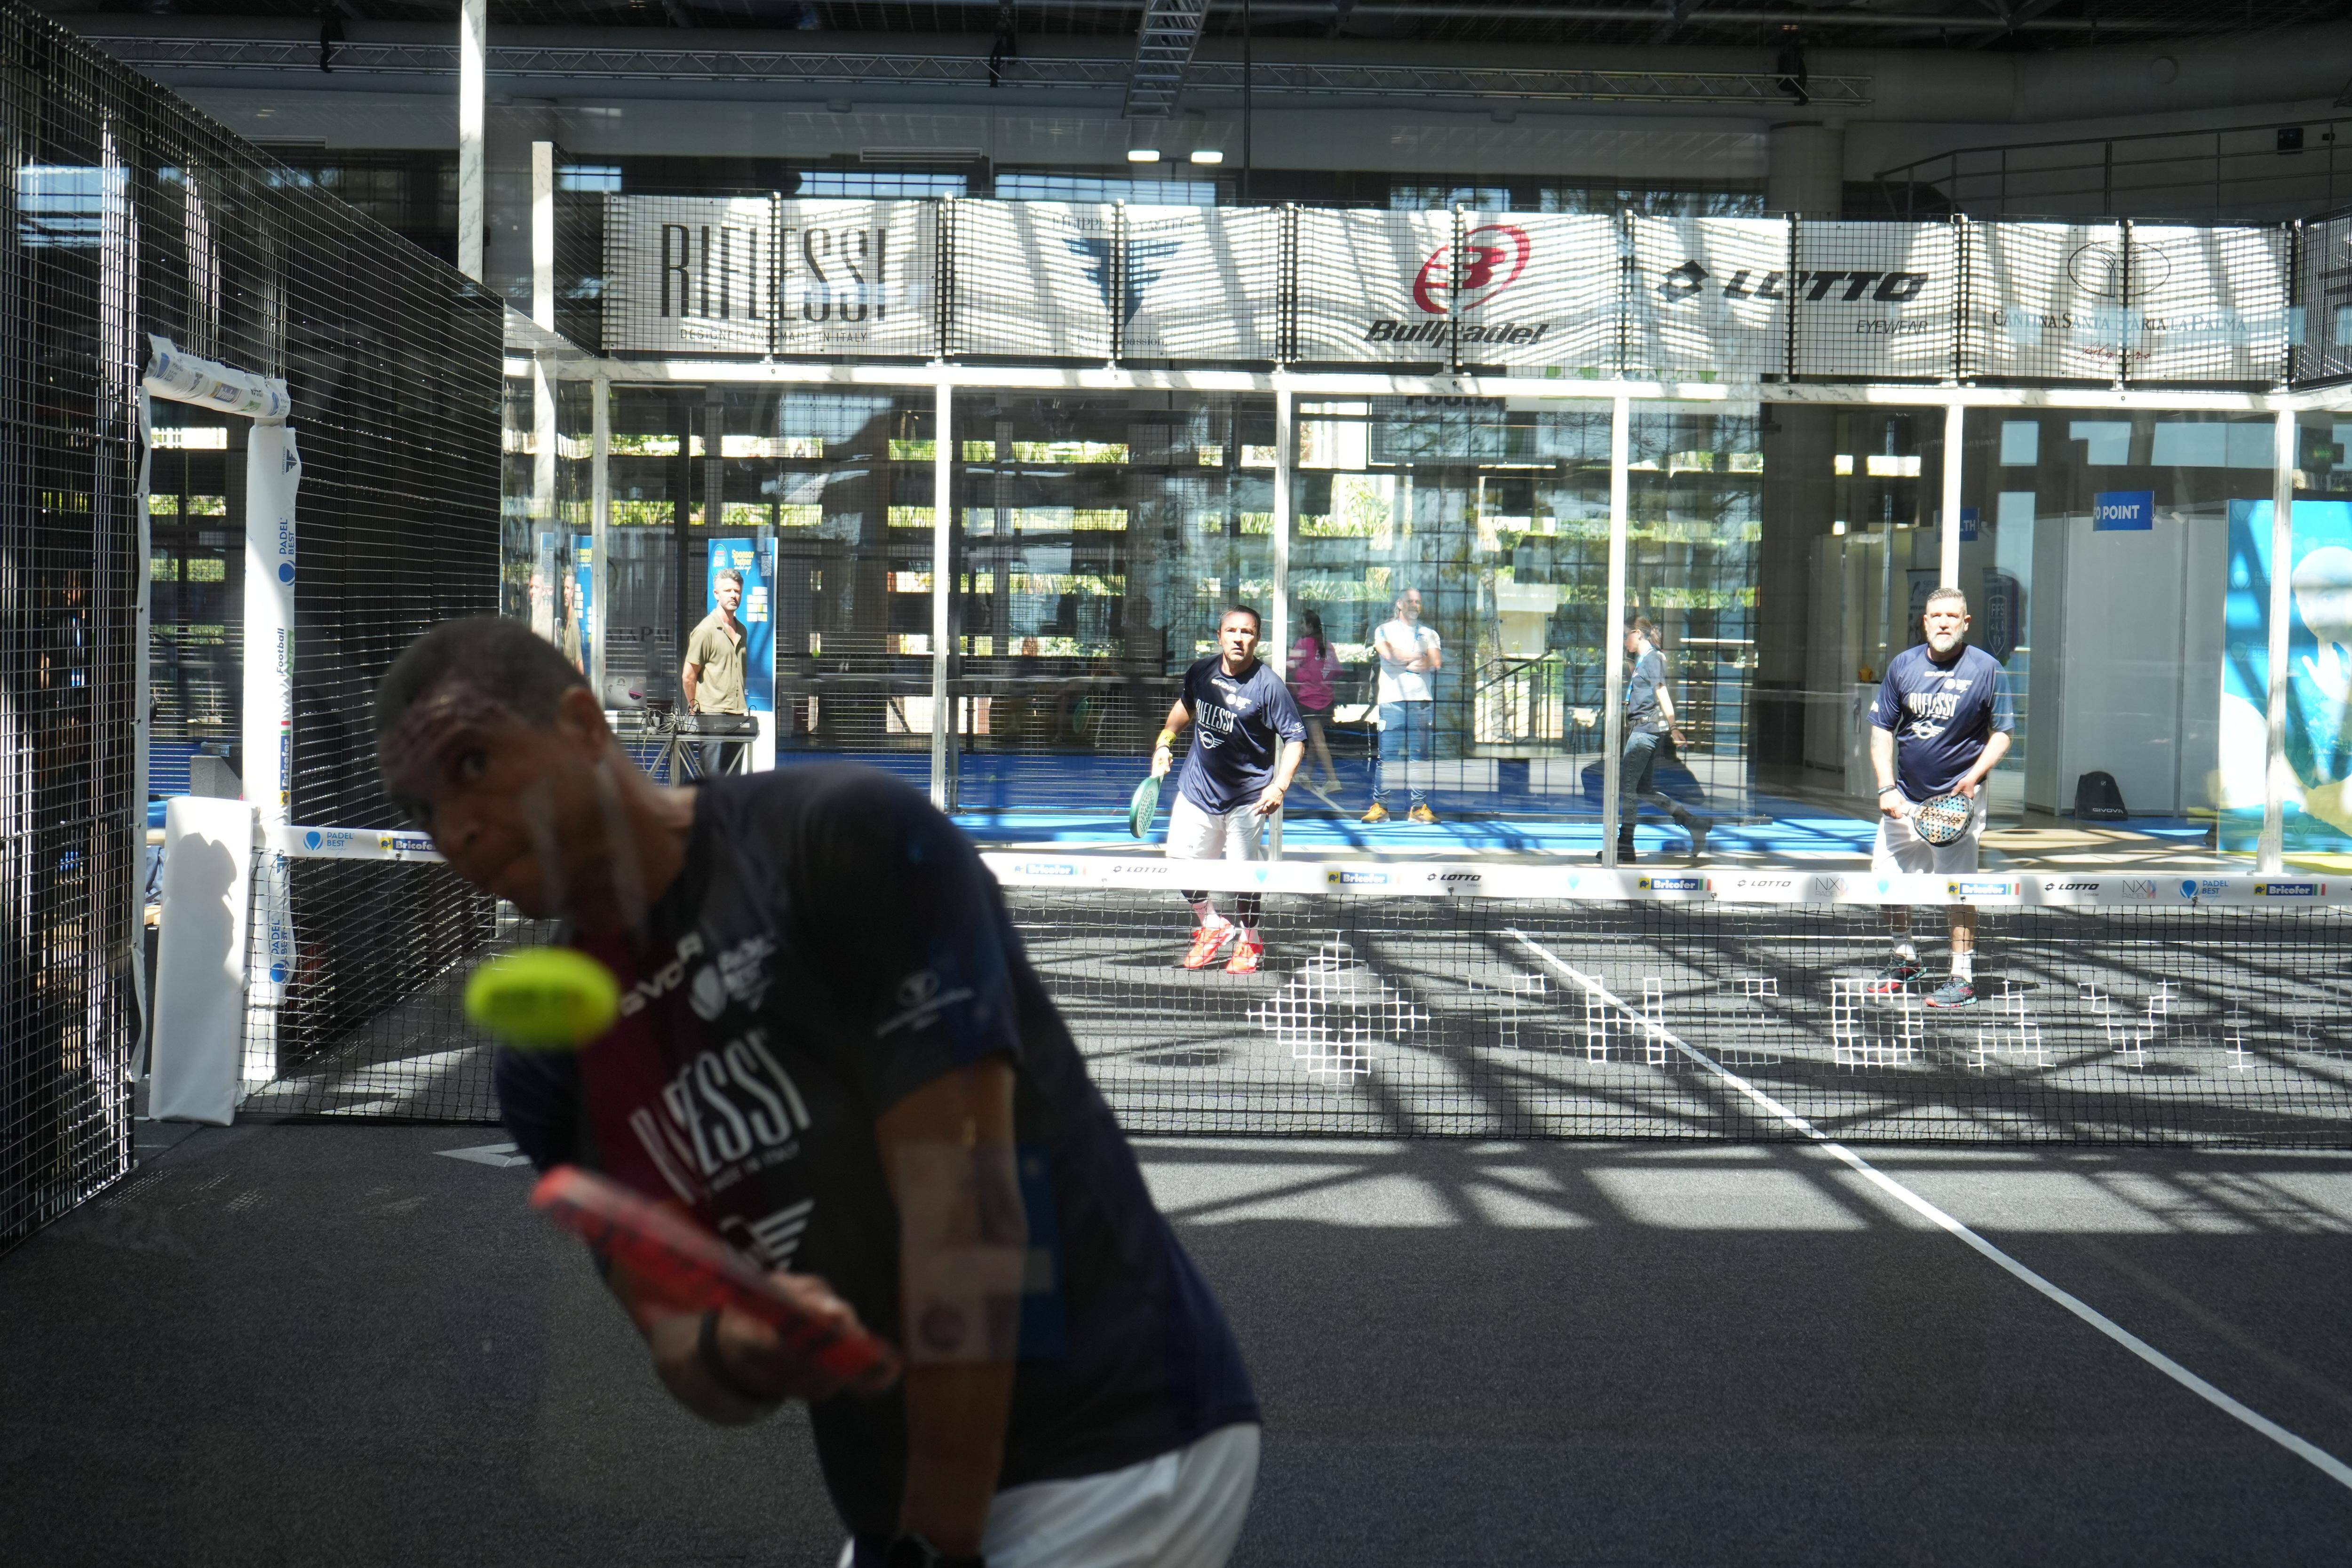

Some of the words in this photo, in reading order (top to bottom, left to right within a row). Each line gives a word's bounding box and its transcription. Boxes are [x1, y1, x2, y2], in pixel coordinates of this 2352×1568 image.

[661, 224, 886, 323] RIFLESSI
[1722, 269, 1929, 302] LOTTO
[1856, 320, 1928, 334] EYEWEAR
[1992, 310, 2058, 328] CANTINA
[2062, 312, 2110, 329] SANTA
[2122, 315, 2166, 331] ARIA
[2193, 314, 2247, 331] PALMA
[680, 329, 743, 340] DESIGNED
[819, 332, 830, 342] IN
[836, 332, 867, 342] ITALY
[2075, 340, 2151, 368] Algro
[2103, 504, 2140, 520] POINT
[1960, 519, 1976, 532] TH
[1196, 698, 1236, 733] RIFLESSI
[396, 841, 434, 850] Bricofe
[1343, 874, 1386, 884] Bricofer
[1653, 879, 1696, 890] Bricofer
[1815, 877, 1841, 891] NX
[2122, 880, 2147, 893] NX
[2269, 886, 2311, 895] Bricofer
[271, 919, 280, 955] PADEL
